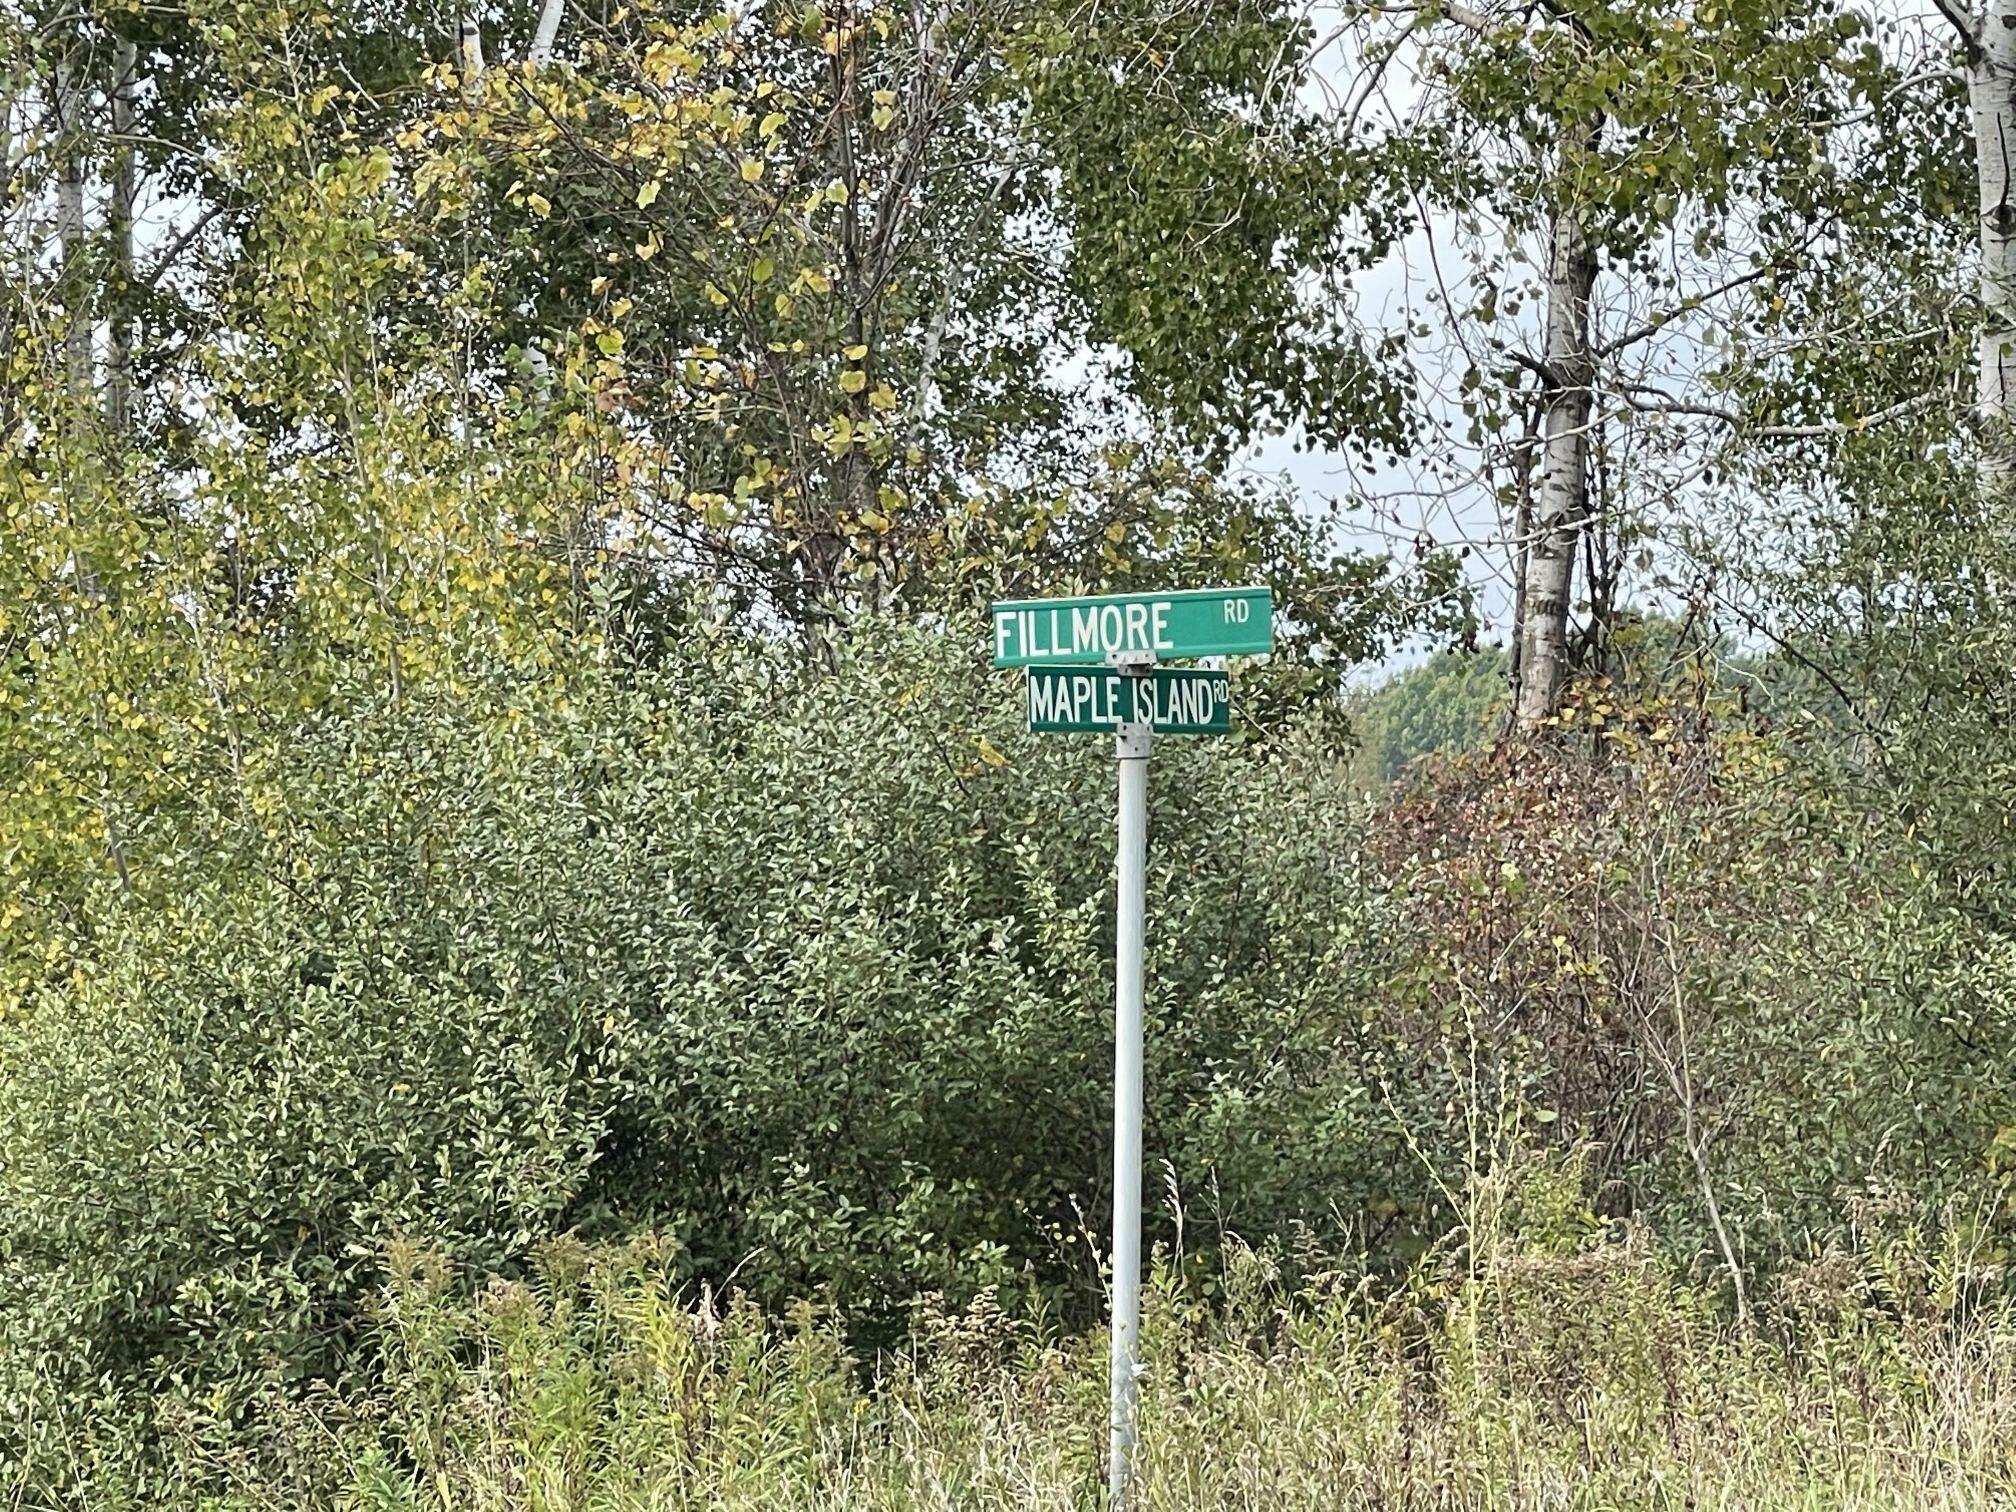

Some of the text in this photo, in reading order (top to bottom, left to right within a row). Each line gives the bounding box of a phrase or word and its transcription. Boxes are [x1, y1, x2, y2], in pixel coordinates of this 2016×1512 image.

[996, 598, 1250, 657] FILLMORE RD
[1029, 675, 1229, 725] MAPLE ISLAND RD
